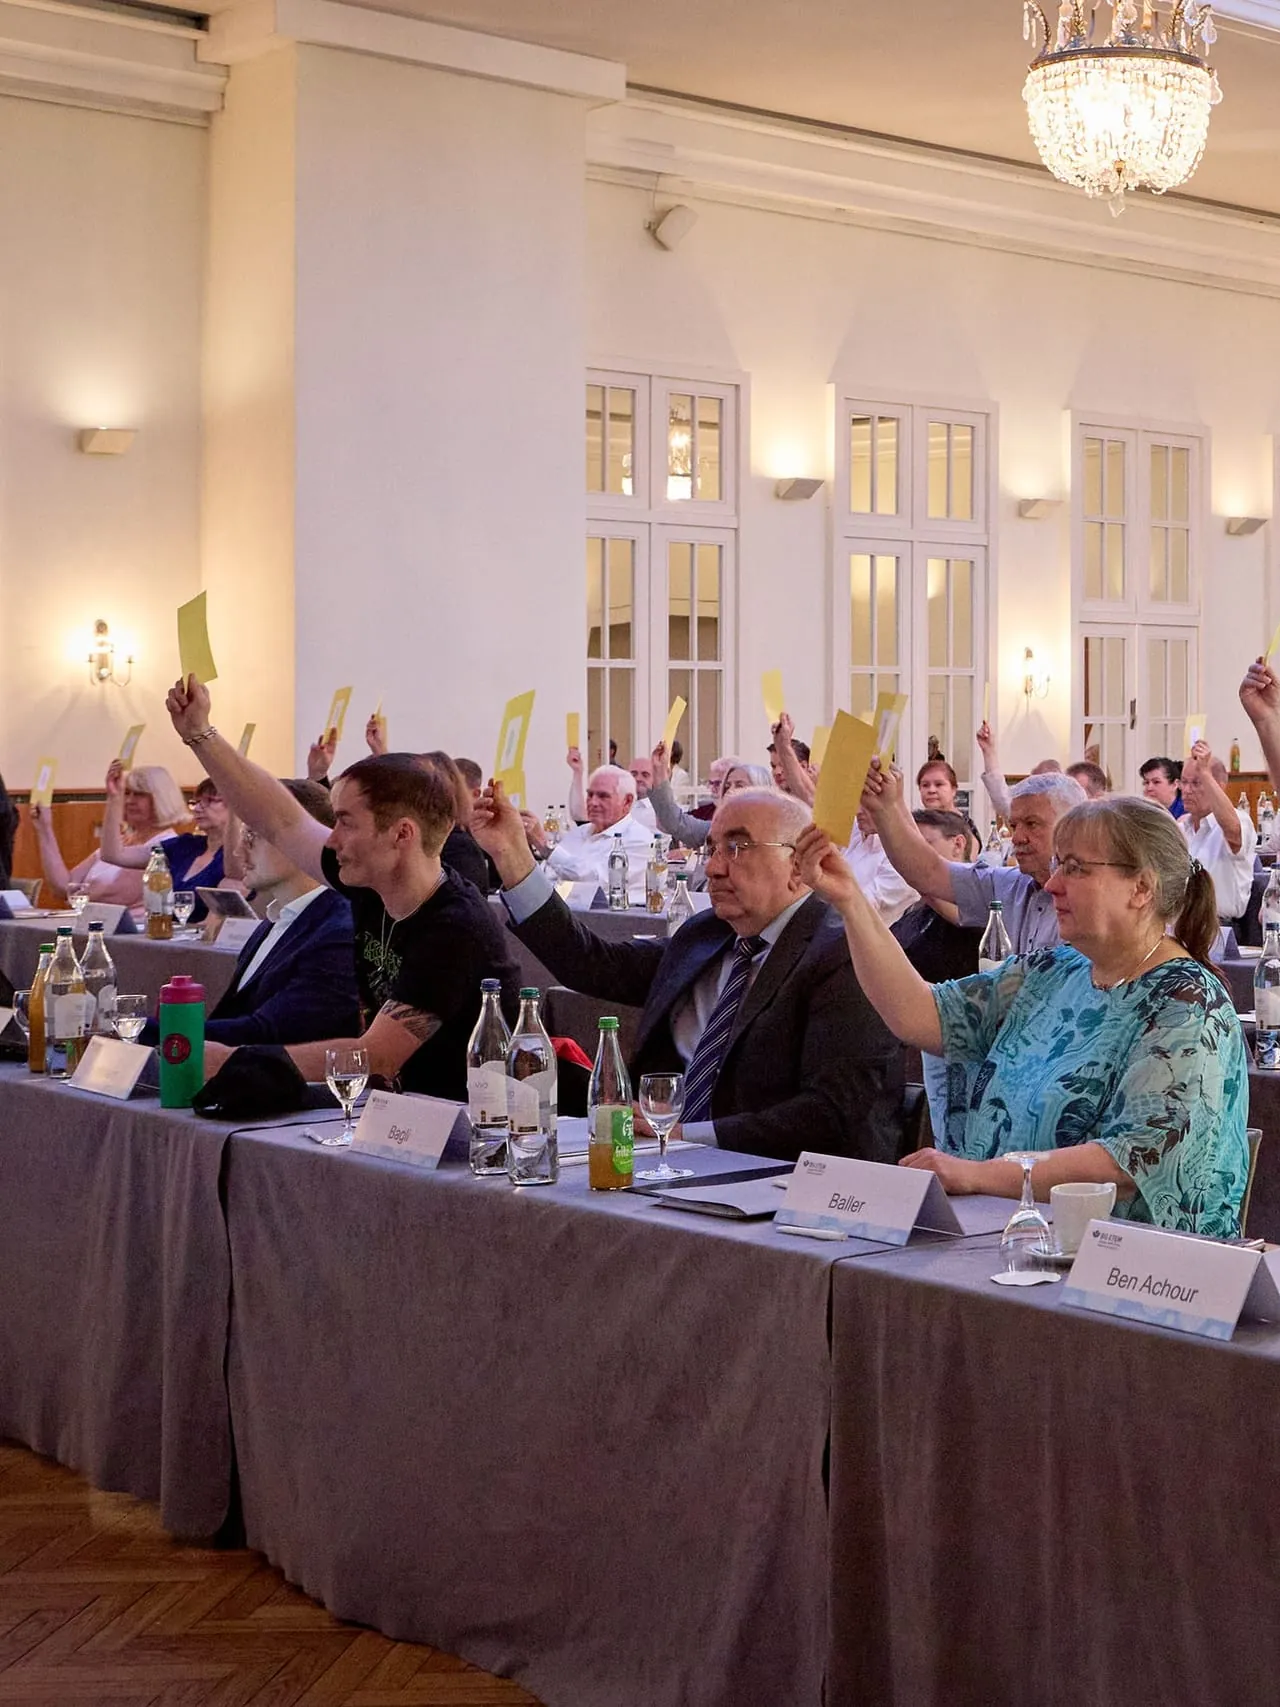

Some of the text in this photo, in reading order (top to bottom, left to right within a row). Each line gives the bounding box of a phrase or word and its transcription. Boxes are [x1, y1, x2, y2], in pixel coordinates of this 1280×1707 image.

[828, 1193, 866, 1214] Baller
[1106, 1267, 1199, 1304] Ben Achour
